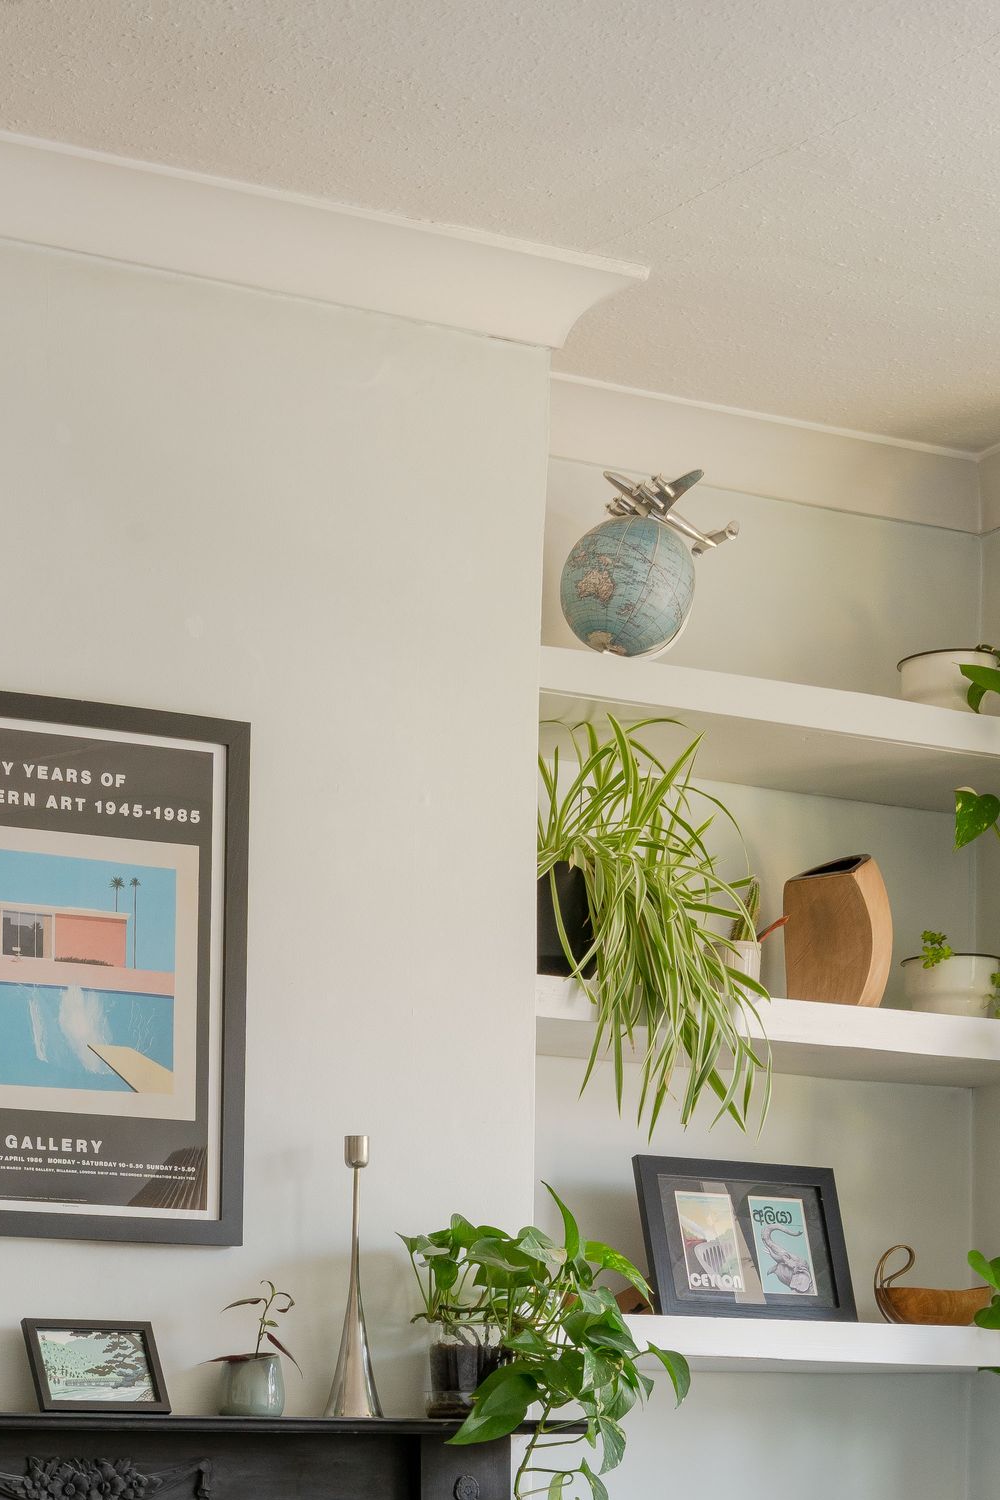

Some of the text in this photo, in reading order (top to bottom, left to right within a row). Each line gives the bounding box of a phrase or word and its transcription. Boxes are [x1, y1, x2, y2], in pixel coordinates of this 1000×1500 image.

[22, 763, 92, 785] YEARS
[100, 772, 126, 788] OF
[45, 794, 86, 811] ART
[94, 800, 200, 824] 1945-1985
[5, 1134, 103, 1154] GALLERY
[47, 1157, 117, 1168] MONDAY SATURDAY
[146, 1163, 173, 1171] SUNDAY
[689, 1271, 742, 1289] CEYLON
